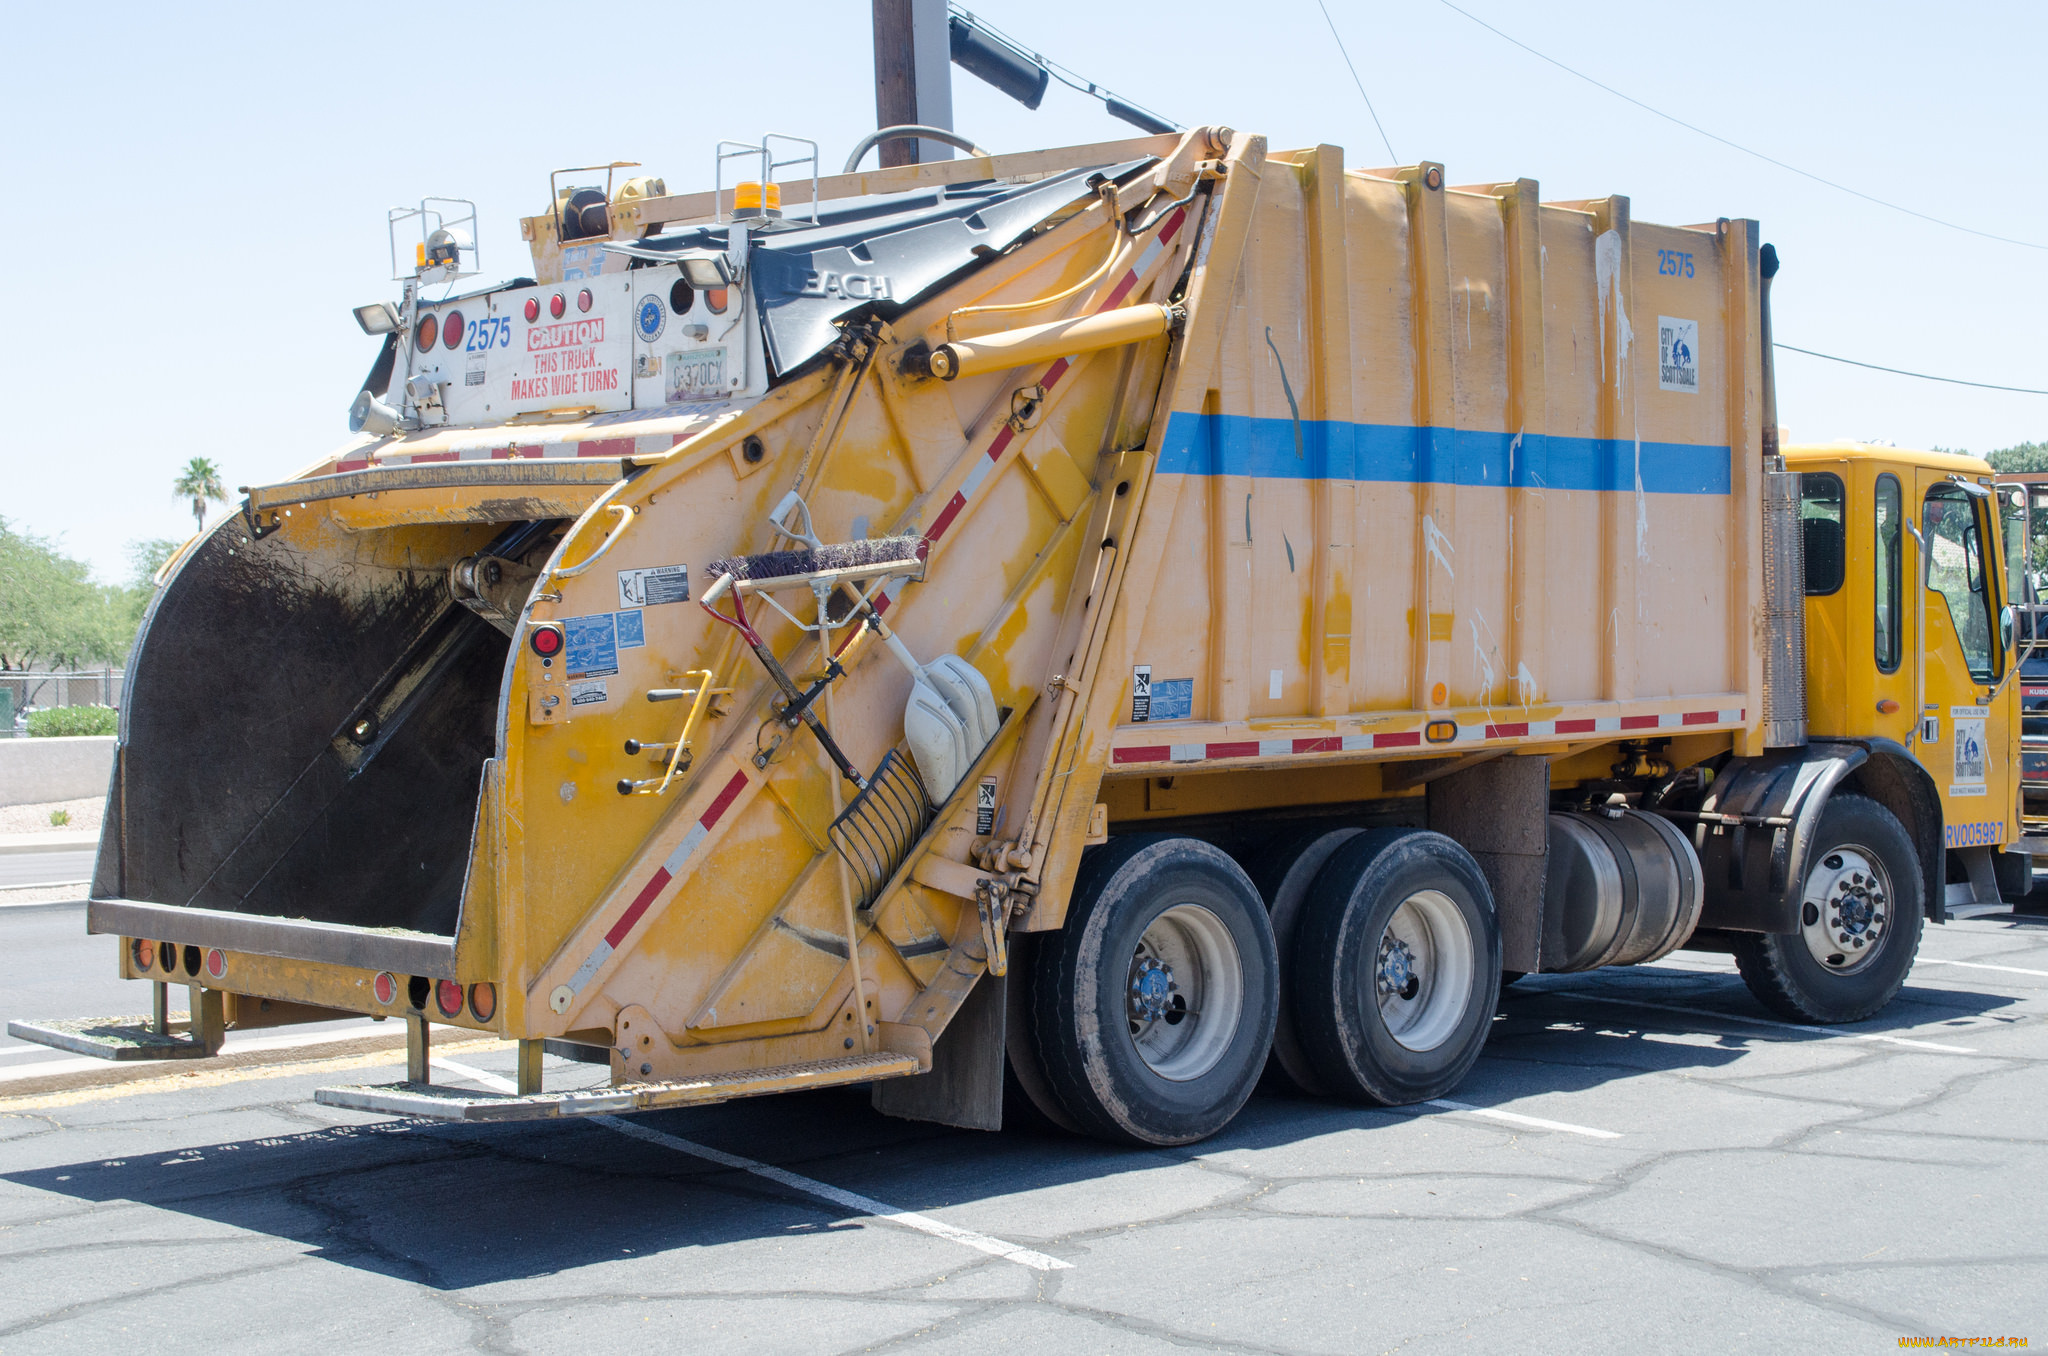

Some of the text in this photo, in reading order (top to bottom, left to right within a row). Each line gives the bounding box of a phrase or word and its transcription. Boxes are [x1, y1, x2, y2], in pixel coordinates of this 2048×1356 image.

[1658, 248, 1695, 279] 2575
[466, 316, 511, 352] 2575
[529, 320, 602, 349] CAUTION
[1660, 327, 1674, 346] CITY
[534, 347, 596, 375] THIS TRUCK
[1661, 346, 1669, 364] OF
[511, 376, 548, 401] MAKES
[551, 373, 578, 396] WIDE
[581, 368, 618, 393] TURNS
[1661, 365, 1696, 386] SCOTTSDALE
[656, 566, 681, 574] WARNING
[1956, 729, 1966, 746] CITY
[1956, 746, 1962, 761] OF
[1955, 761, 1982, 777] SCOTTSDALE
[1946, 822, 2003, 848] RV005987
